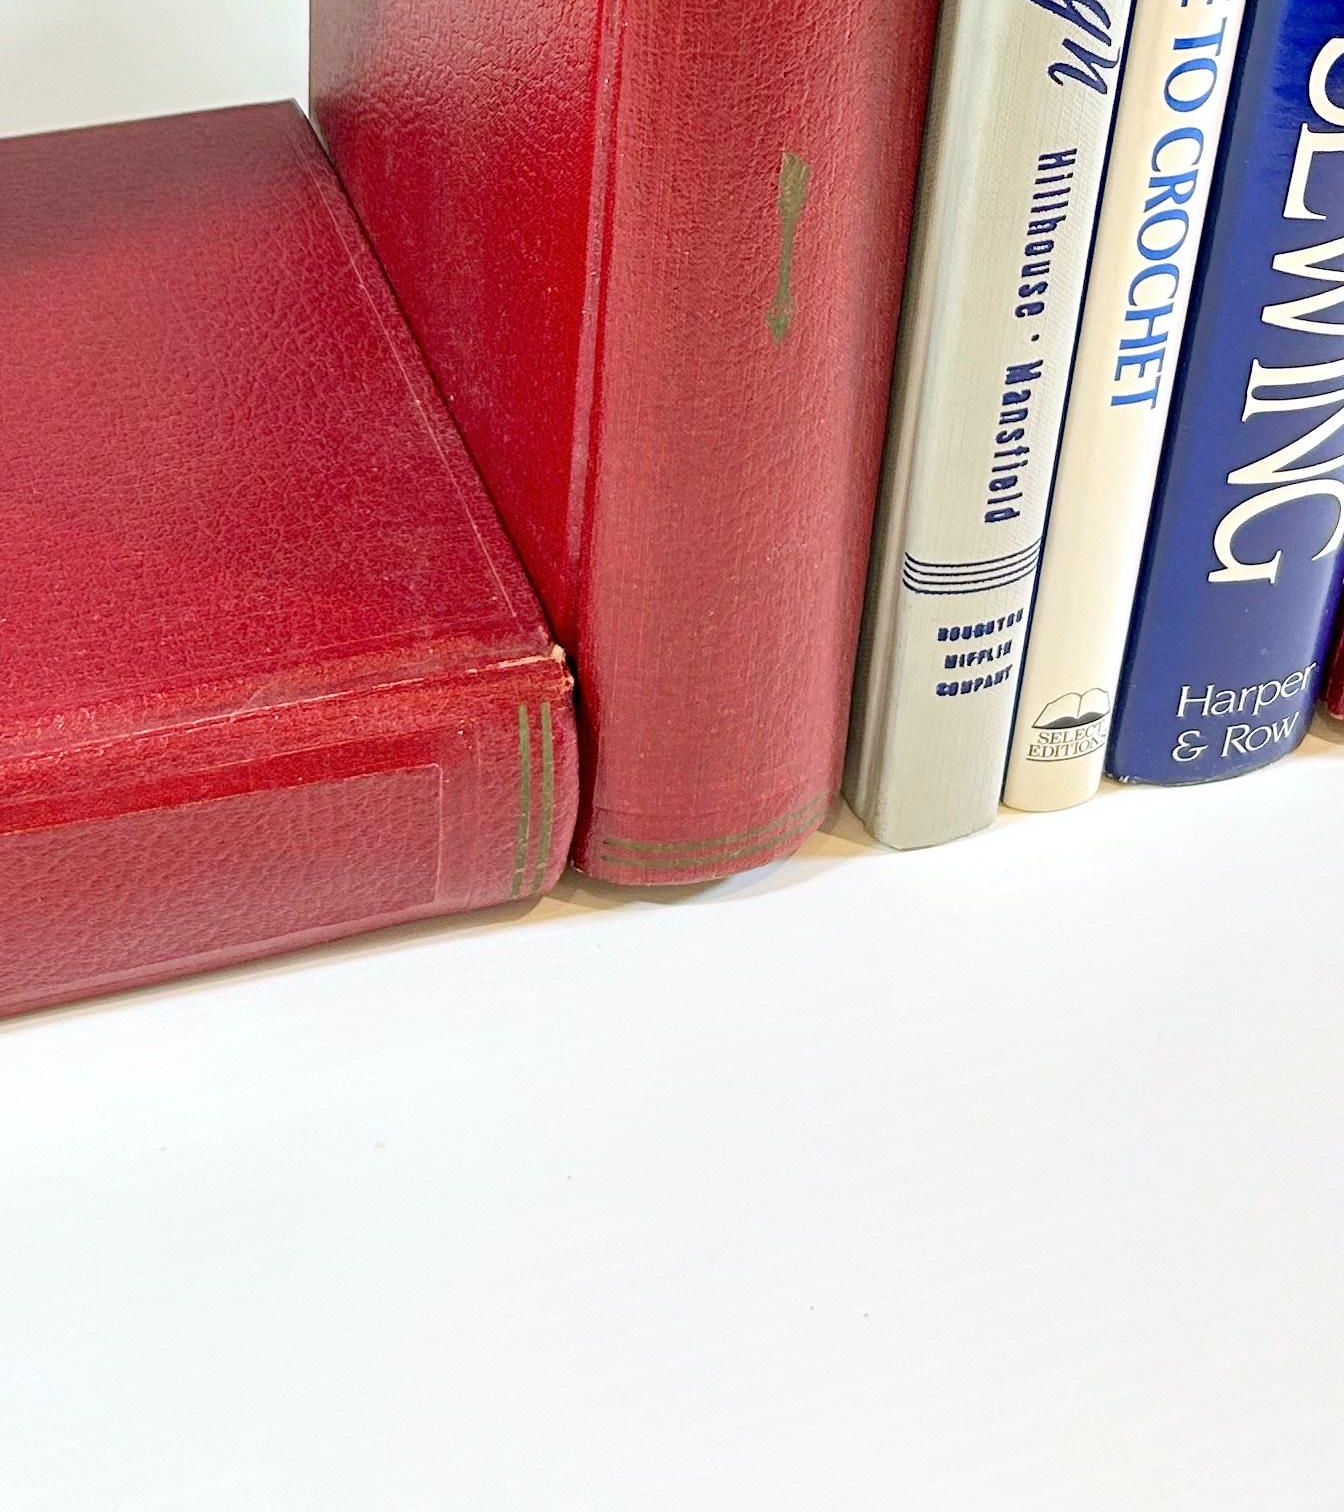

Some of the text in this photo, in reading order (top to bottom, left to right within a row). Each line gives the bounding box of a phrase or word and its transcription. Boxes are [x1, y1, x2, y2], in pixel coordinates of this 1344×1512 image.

[1162, 18, 1226, 113] TO
[1110, 127, 1205, 409] CROCHET
[984, 148, 1078, 524] Hillhouse Mansfield
[1176, 661, 1317, 719] Harper
[1037, 719, 1105, 745] SELECT
[1171, 712, 1300, 763] & Row
